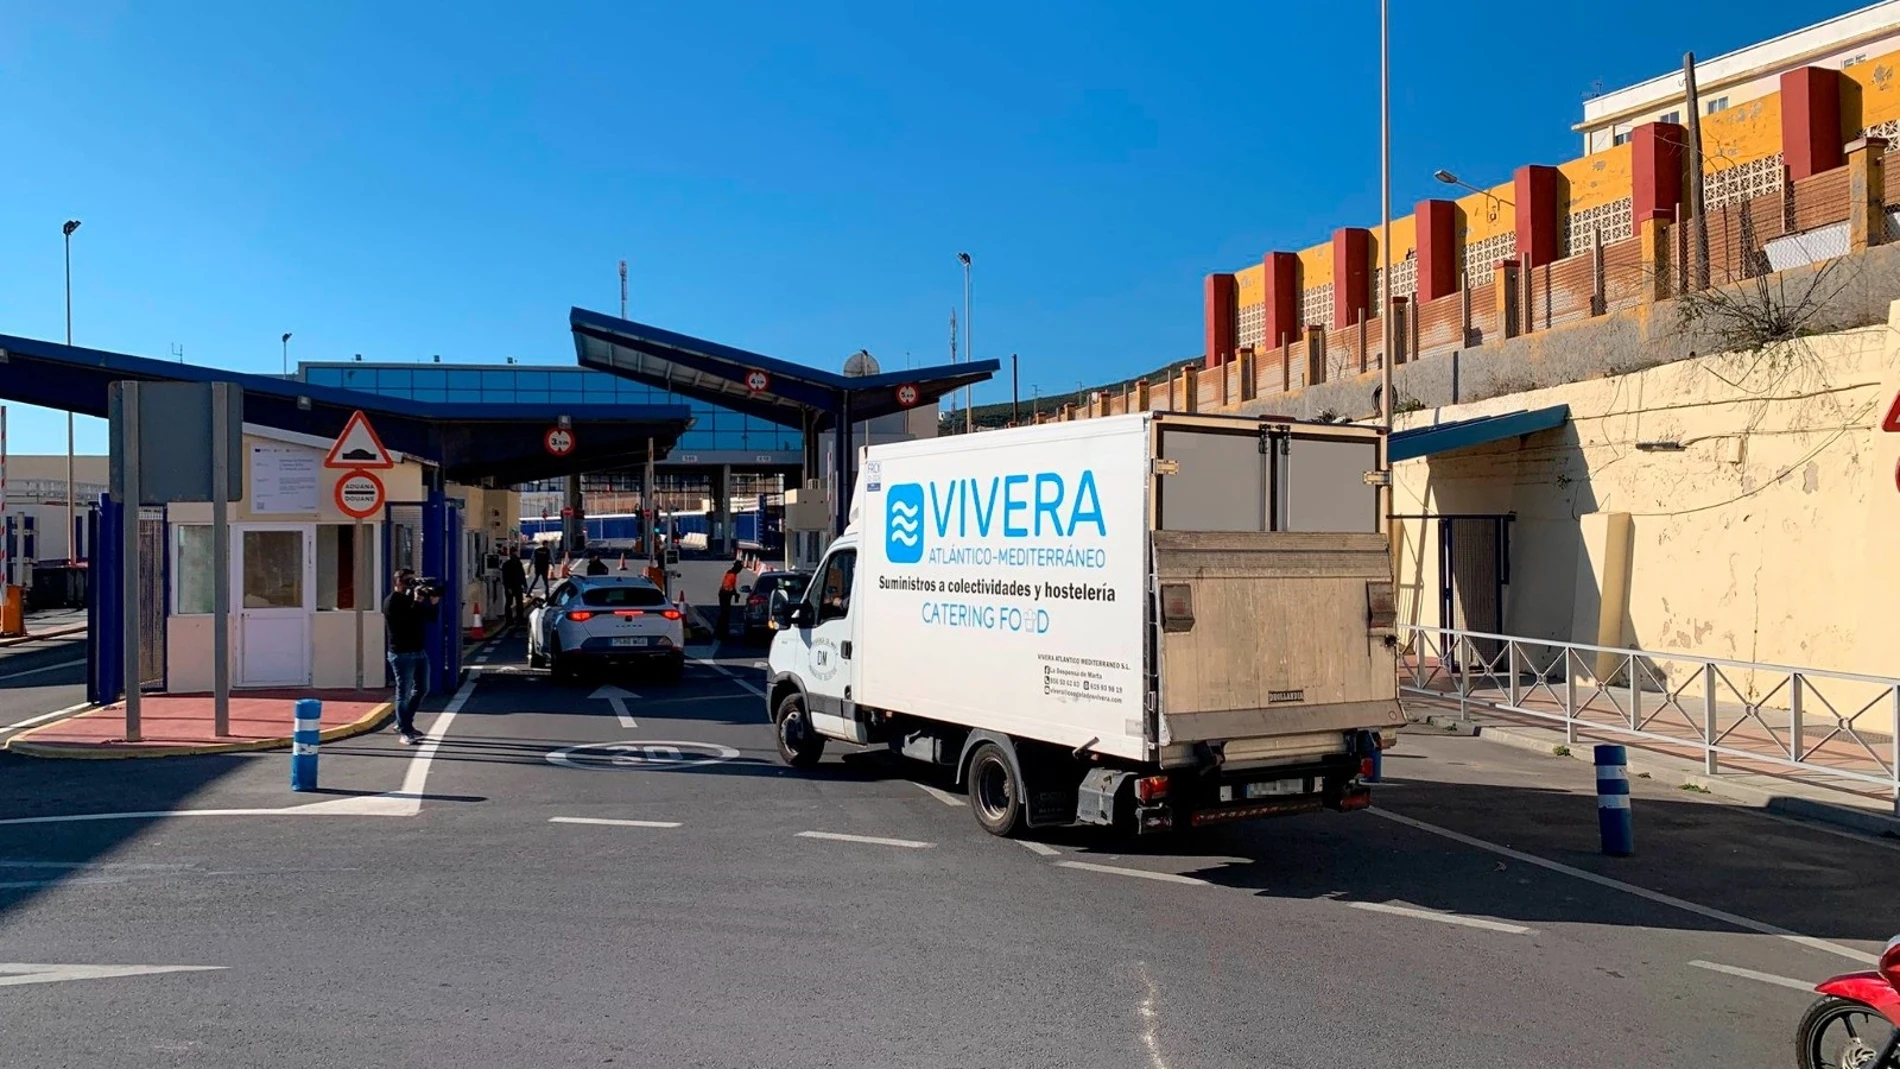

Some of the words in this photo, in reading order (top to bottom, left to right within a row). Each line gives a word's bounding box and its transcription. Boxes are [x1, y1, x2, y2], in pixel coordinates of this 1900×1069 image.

[929, 469, 1107, 538] VIVERA
[928, 544, 1106, 568] ATLÁNTICO-MEDITERRÁNEO
[879, 575, 936, 592] Suministros
[938, 579, 945, 592] a
[948, 578, 1032, 598] colectividades
[1034, 584, 1042, 601] y
[1044, 581, 1116, 602] hostelería
[922, 602, 995, 629] CATERING
[817, 650, 828, 666] DM
[1037, 653, 1054, 661] VIVERA
[1055, 655, 1080, 664] ATLANTICO
[1081, 658, 1121, 669] MEDITERRANEO
[1057, 667, 1080, 677] Despensa
[1087, 671, 1102, 679] Marta
